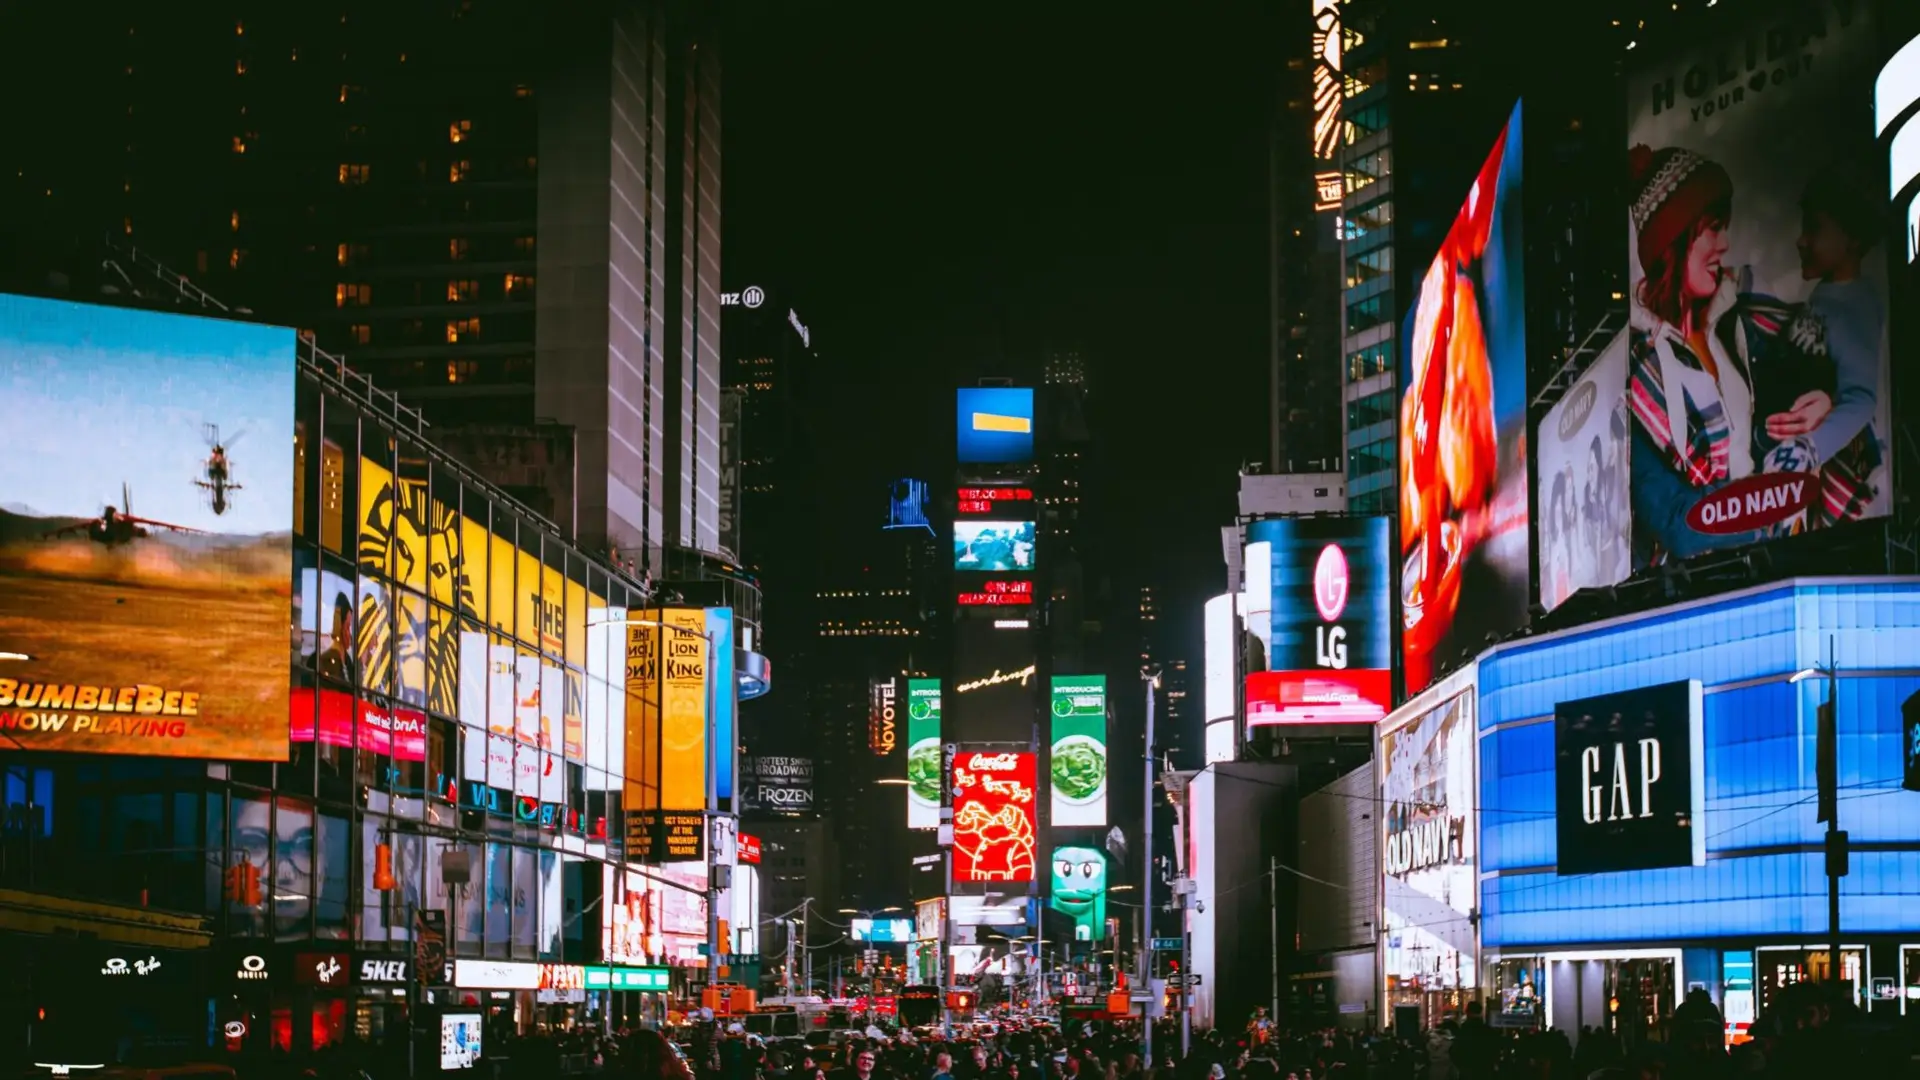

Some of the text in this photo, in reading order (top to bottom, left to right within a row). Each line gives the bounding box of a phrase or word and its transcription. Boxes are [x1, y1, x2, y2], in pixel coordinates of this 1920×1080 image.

[1691, 86, 1745, 121] YOUR
[719, 423, 735, 533] TIMES
[1701, 480, 1804, 525] OLD NAVY
[532, 593, 562, 640] THE
[667, 659, 703, 679] KING
[669, 640, 698, 657] LION
[1316, 625, 1348, 670] LG
[0, 678, 200, 716] BUMBLEBEE
[880, 677, 896, 754] NOVOTEL
[0, 712, 186, 738] NOW PLAYING
[758, 784, 813, 805] FROZEN
[1582, 738, 1661, 824] GAP
[1387, 814, 1449, 876] OLD NAVY
